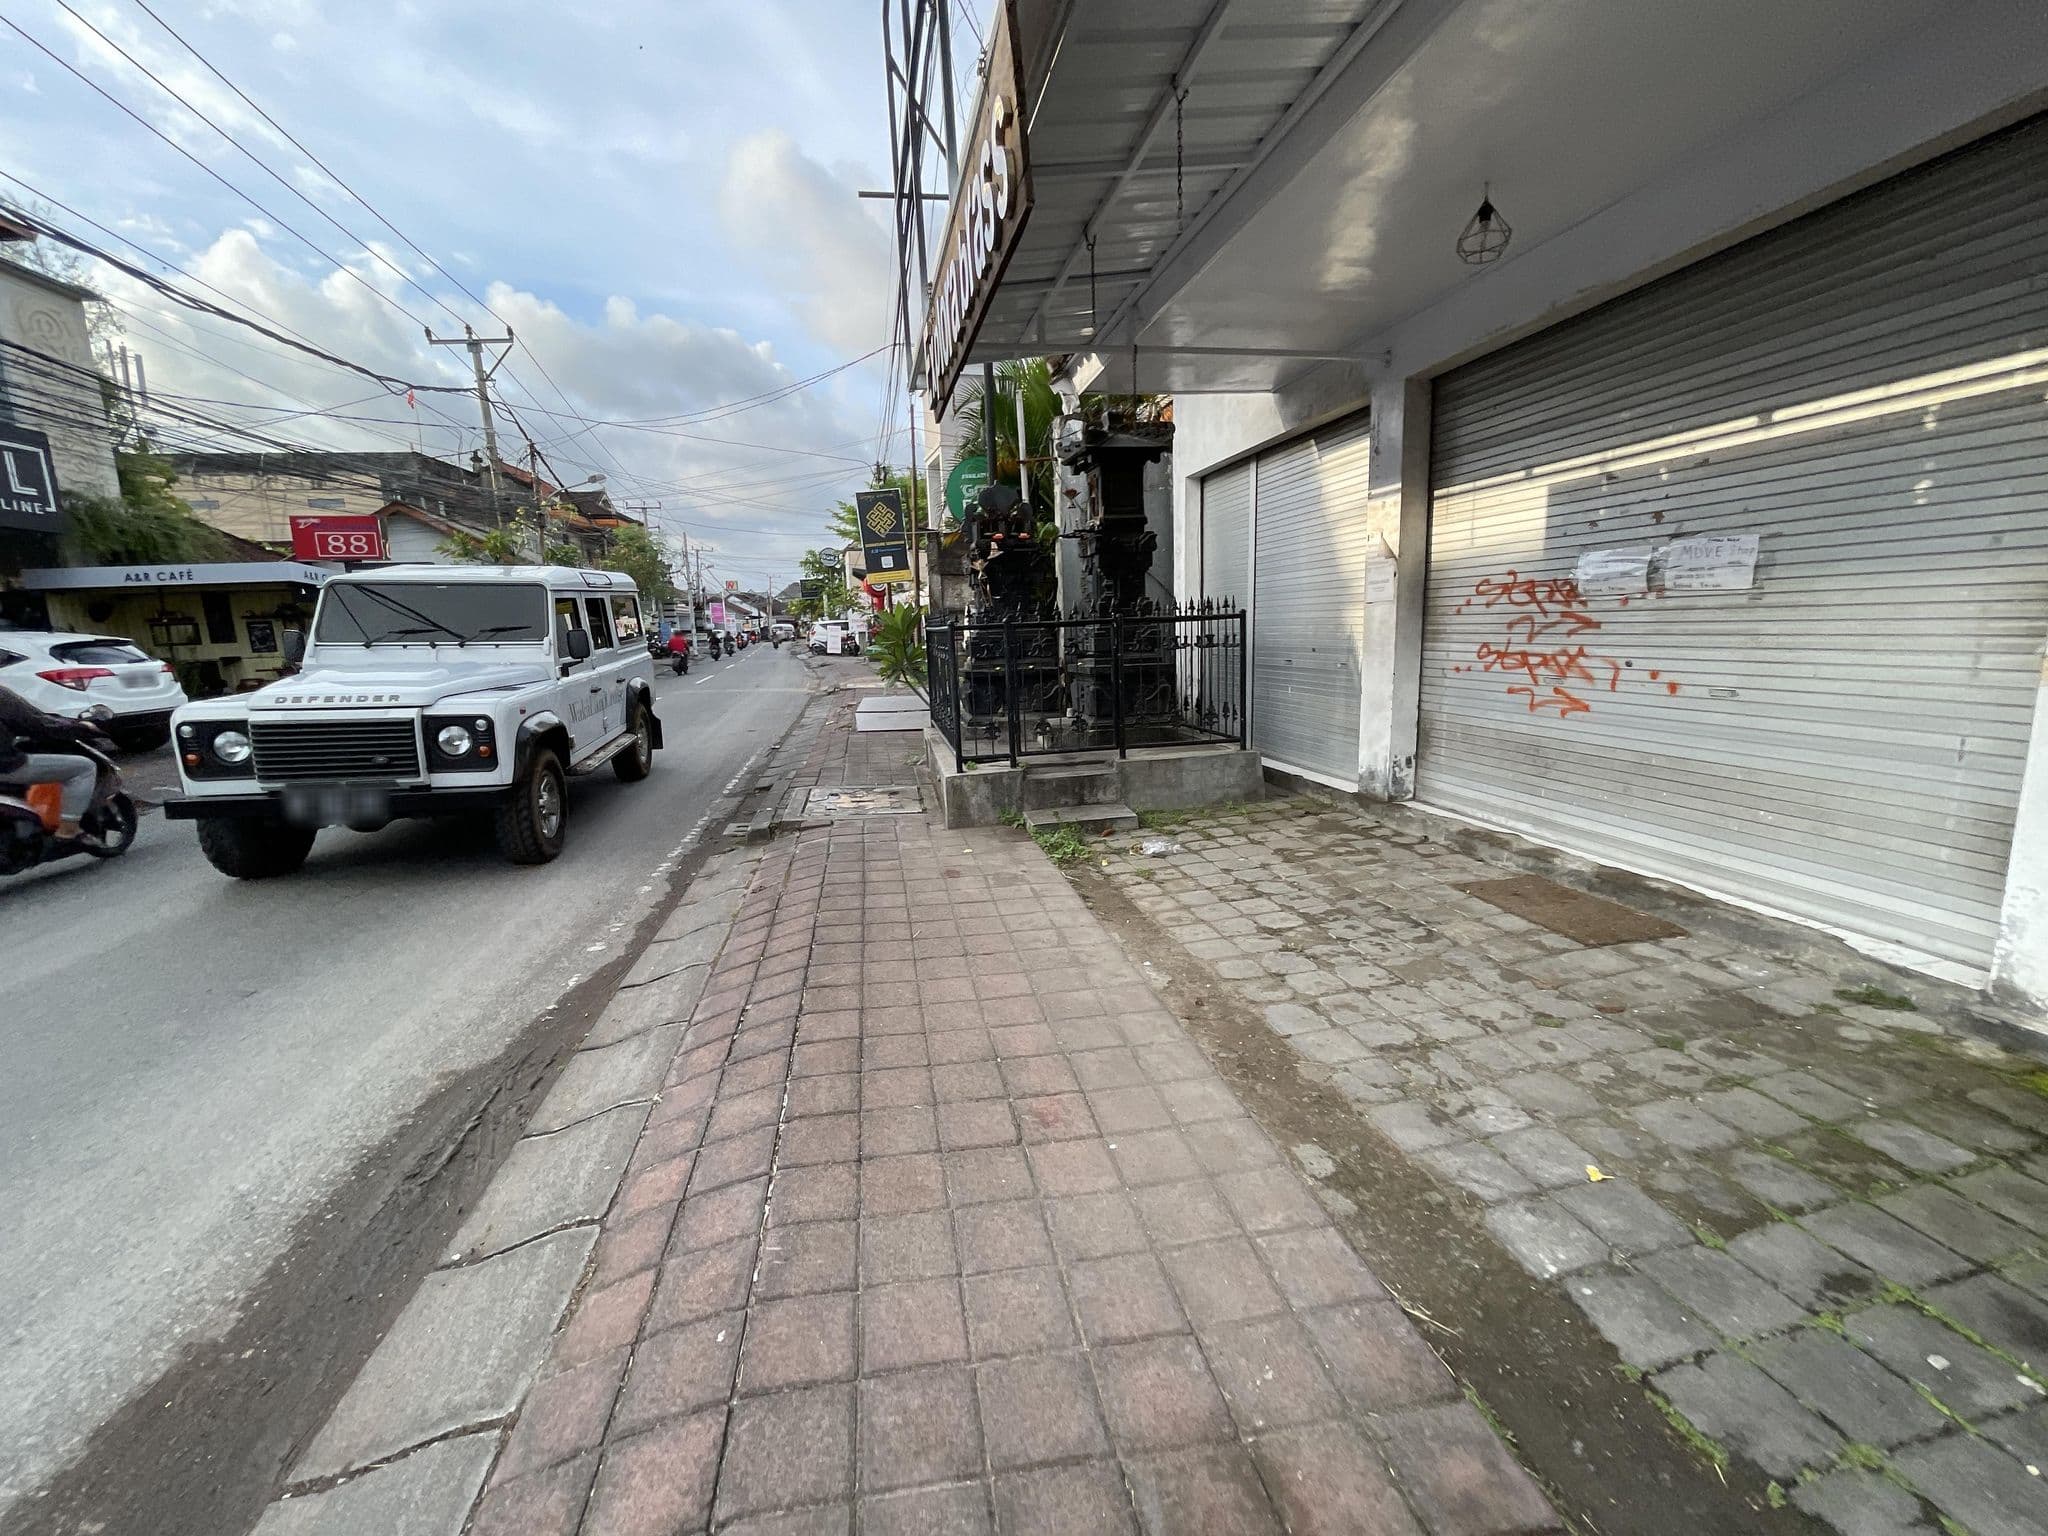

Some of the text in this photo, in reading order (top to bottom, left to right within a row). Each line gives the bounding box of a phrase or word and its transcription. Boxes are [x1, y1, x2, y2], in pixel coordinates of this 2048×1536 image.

[327, 534, 369, 555] 88
[125, 571, 151, 583] A&R
[274, 694, 401, 705] DEFENDER
